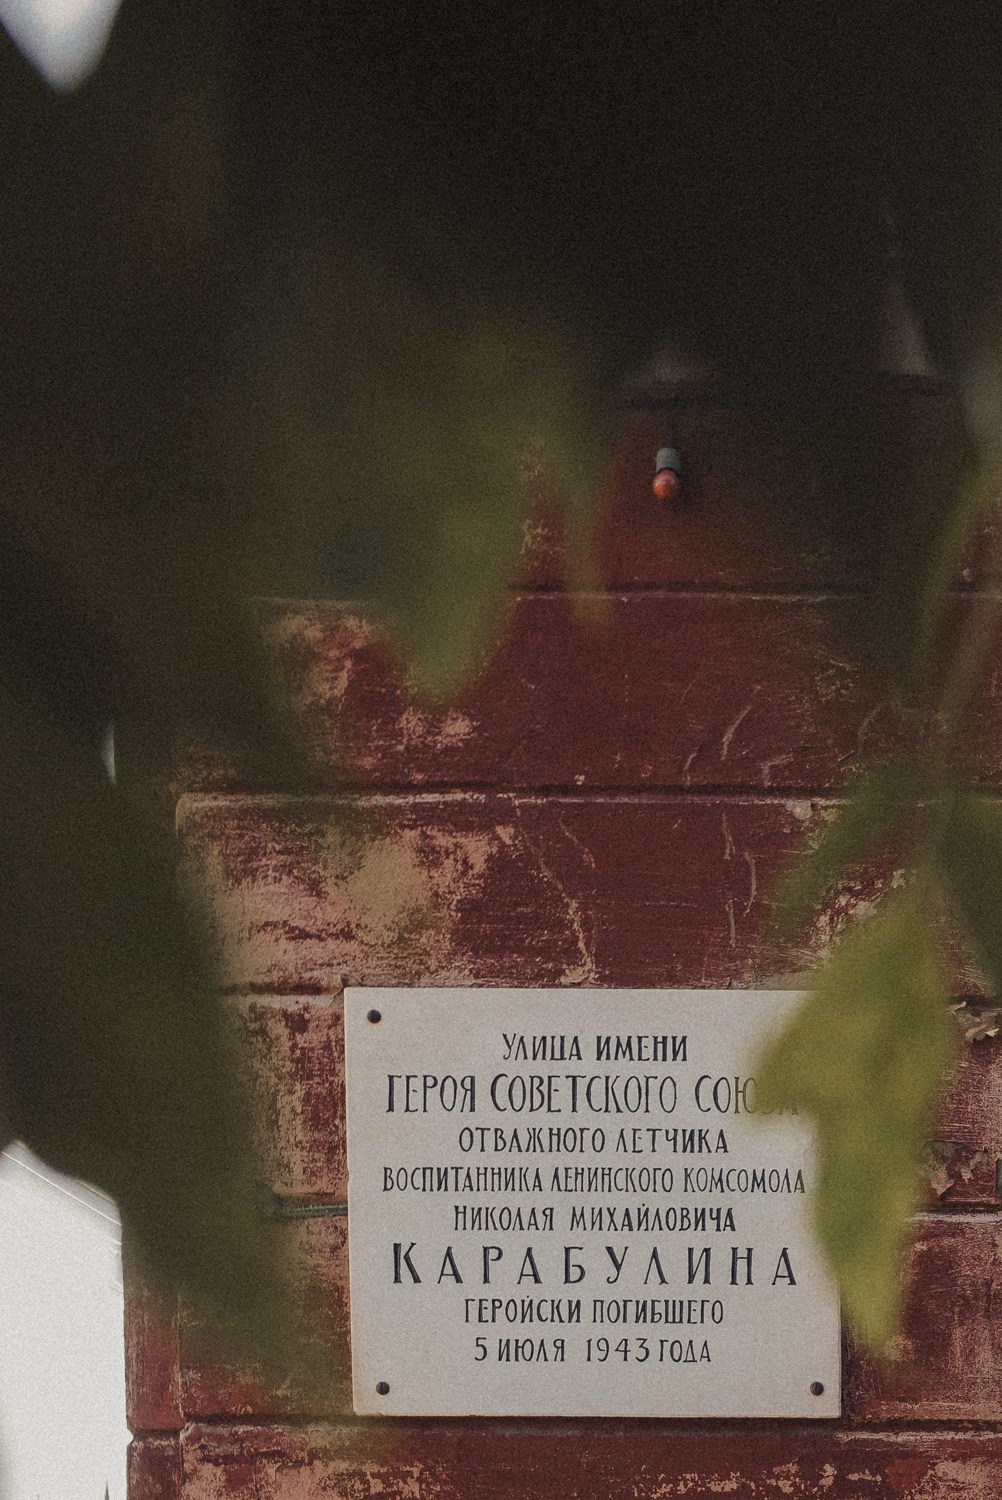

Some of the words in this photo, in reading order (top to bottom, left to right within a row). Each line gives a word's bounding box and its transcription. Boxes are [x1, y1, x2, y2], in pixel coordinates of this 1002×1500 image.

[502, 1034, 582, 1061] УЛИЦА
[596, 1036, 687, 1062] ИМЕНИ
[386, 1075, 475, 1113] ГЕРОЯ
[490, 1073, 677, 1113] СОВЕТСКОГО
[459, 1127, 605, 1153] ОТВАЖНОГО
[616, 1128, 728, 1153] ЛЕТЧИКА
[383, 1167, 543, 1192] ВОСПИТАННИКА
[551, 1167, 673, 1192] ЛЕНИНСКОГО
[684, 1168, 805, 1193] КОМСОМОЛА
[454, 1205, 554, 1231] НИКОЛАЯ
[570, 1203, 736, 1232] МИХАЙЛОВИЧА
[393, 1242, 796, 1285] КАРАБУЛИНА
[465, 1296, 581, 1323] ГЕРОЙСКИ
[593, 1299, 723, 1324] ПОГИБШЕГО
[475, 1337, 487, 1361] 5
[498, 1339, 565, 1362] ИЮЛЯ
[587, 1338, 649, 1362] 1943
[659, 1340, 711, 1363] ГОДА
